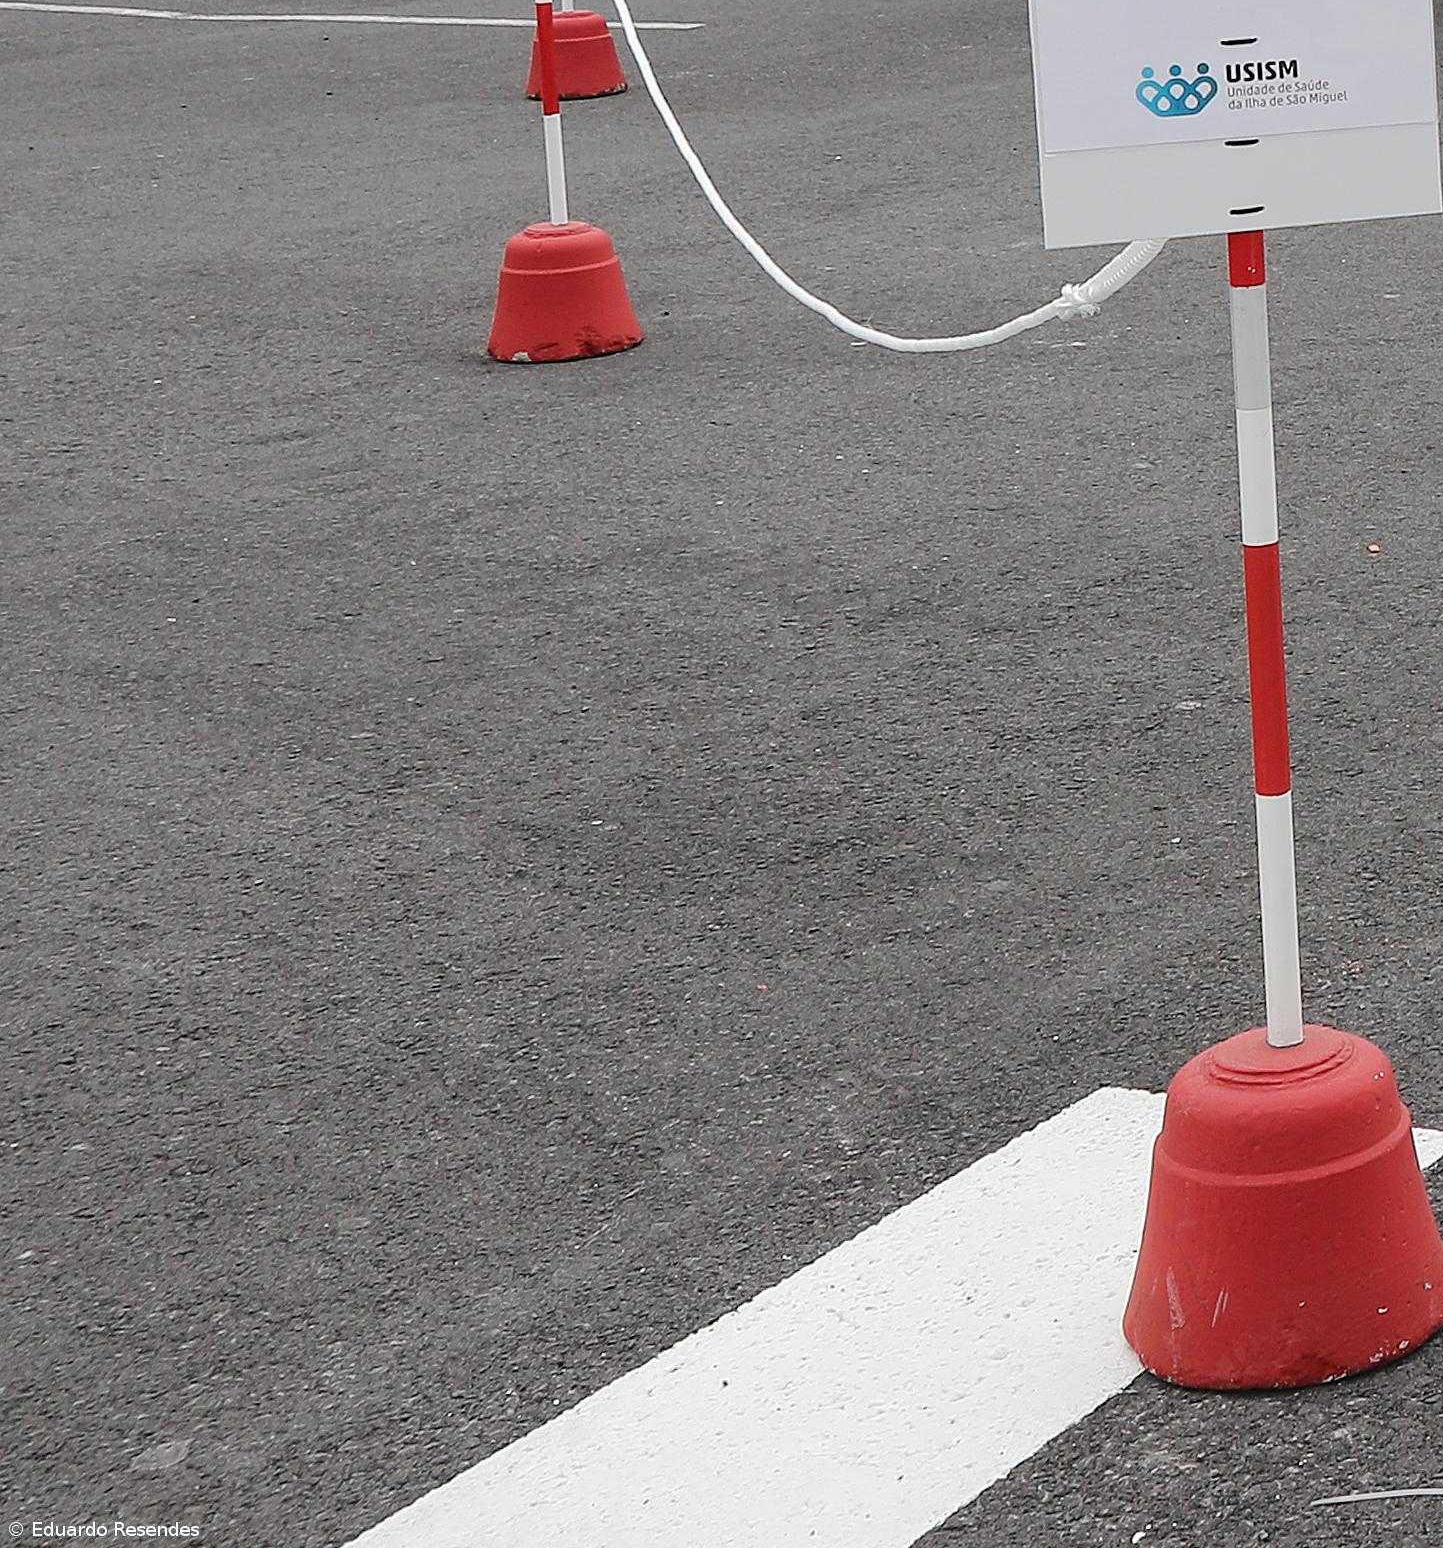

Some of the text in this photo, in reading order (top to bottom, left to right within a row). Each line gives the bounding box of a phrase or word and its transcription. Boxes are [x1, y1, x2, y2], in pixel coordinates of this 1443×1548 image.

[1225, 59, 1298, 83] USISM
[1227, 79, 1329, 97] Unidade de Saúde
[1228, 90, 1348, 110] da Ilha de São Miguel
